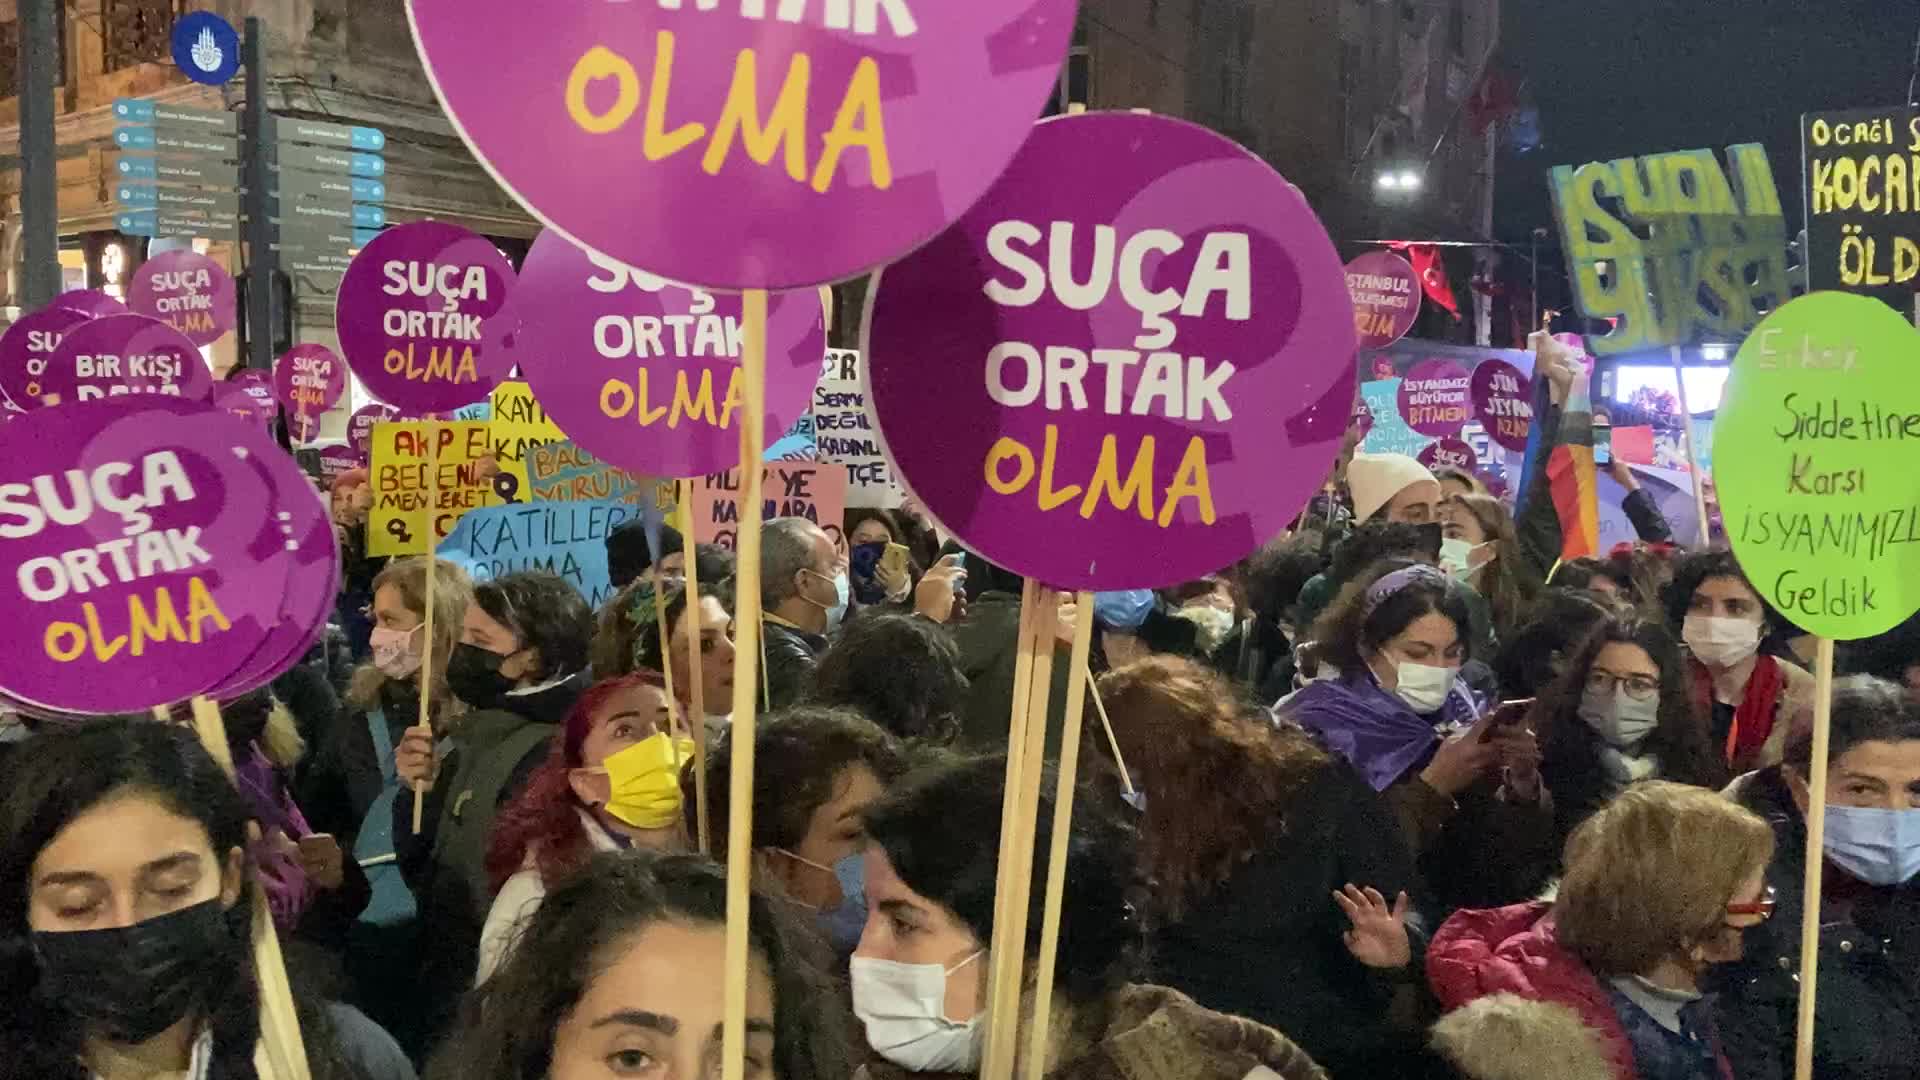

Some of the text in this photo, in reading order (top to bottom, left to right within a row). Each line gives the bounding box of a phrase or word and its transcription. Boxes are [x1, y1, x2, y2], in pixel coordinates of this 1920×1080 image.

[565, 31, 891, 192] OLMA
[1812, 153, 1920, 215] KOCA
[151, 268, 211, 295] SUÇA
[984, 220, 1250, 349] SUÇA
[1840, 224, 1920, 286] ÖLD
[155, 293, 212, 313] ORTAK
[382, 260, 487, 313] SUÇA
[26, 330, 63, 352] SU
[384, 309, 482, 341] ORTAK
[383, 348, 478, 383] OLMA
[985, 341, 1235, 421] ORTAK
[818, 435, 882, 456] KADINL
[0, 451, 196, 537] SUÇA
[984, 424, 1216, 527] OLMA
[1741, 504, 1920, 561] İSYANIMIZL
[18, 526, 211, 601] ORTAK
[1775, 569, 1878, 616] Geldik
[44, 576, 231, 662] OLMA
